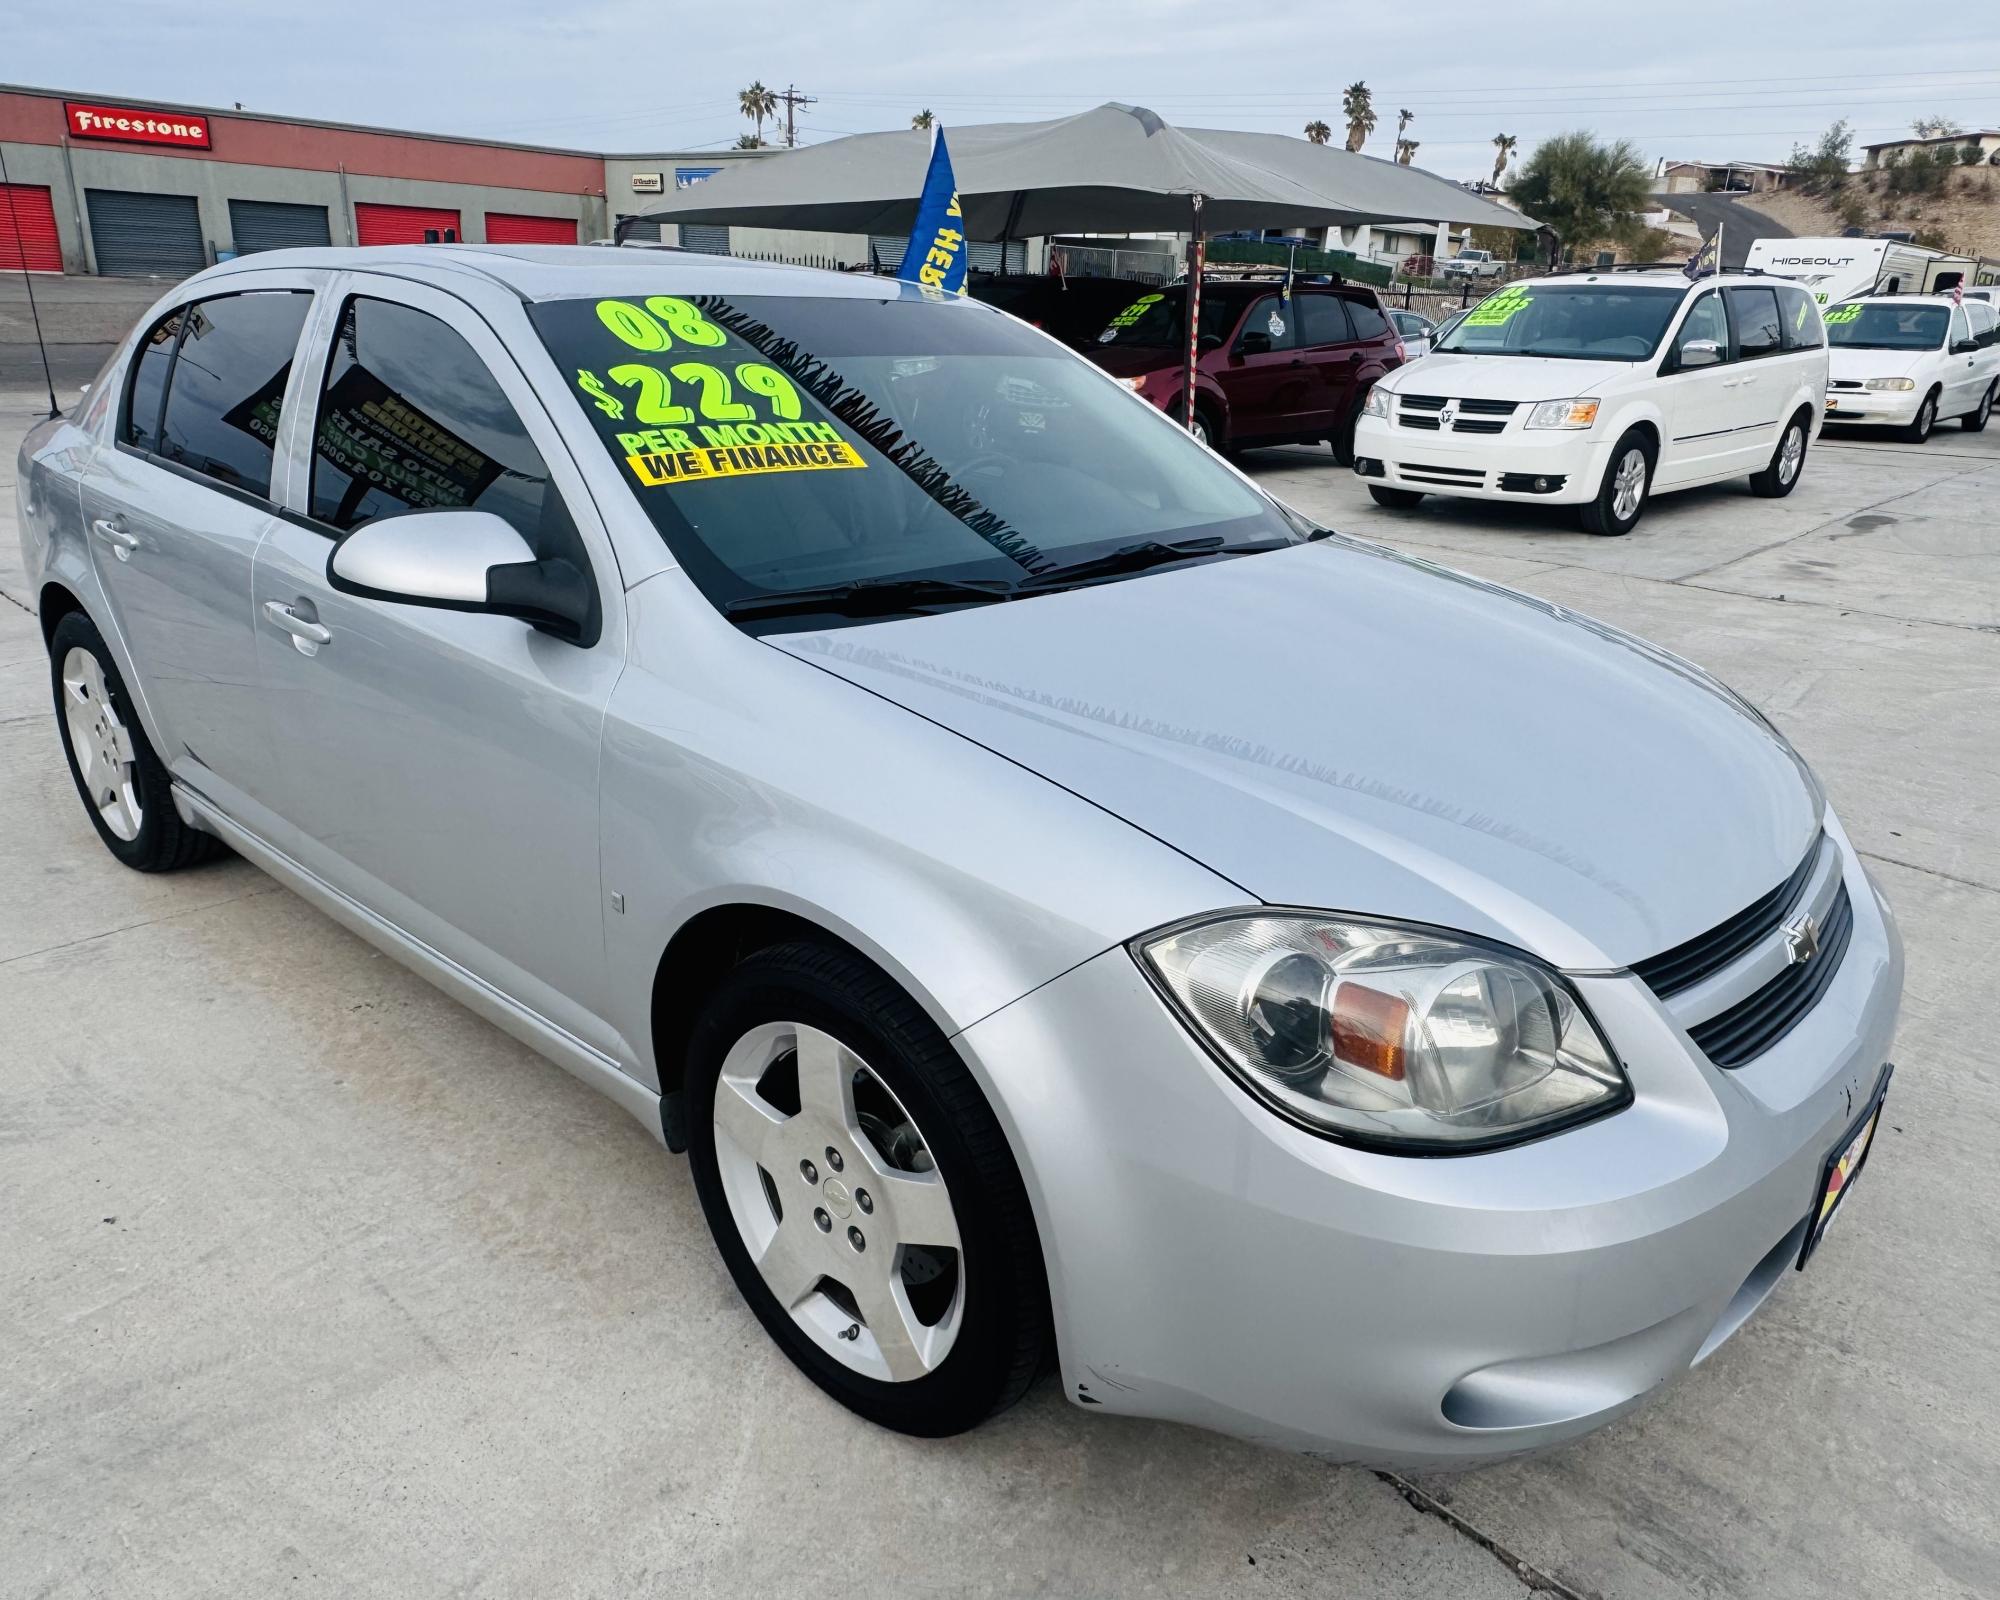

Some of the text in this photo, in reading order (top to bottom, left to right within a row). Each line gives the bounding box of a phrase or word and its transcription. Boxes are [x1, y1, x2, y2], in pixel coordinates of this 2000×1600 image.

[75, 111, 203, 138] Firestone
[1772, 257, 1855, 266] HIDEOUT
[595, 296, 728, 352] 08
[577, 362, 802, 425] $229
[615, 421, 844, 458] PER MONTH
[642, 444, 857, 482] WE FINANCE
